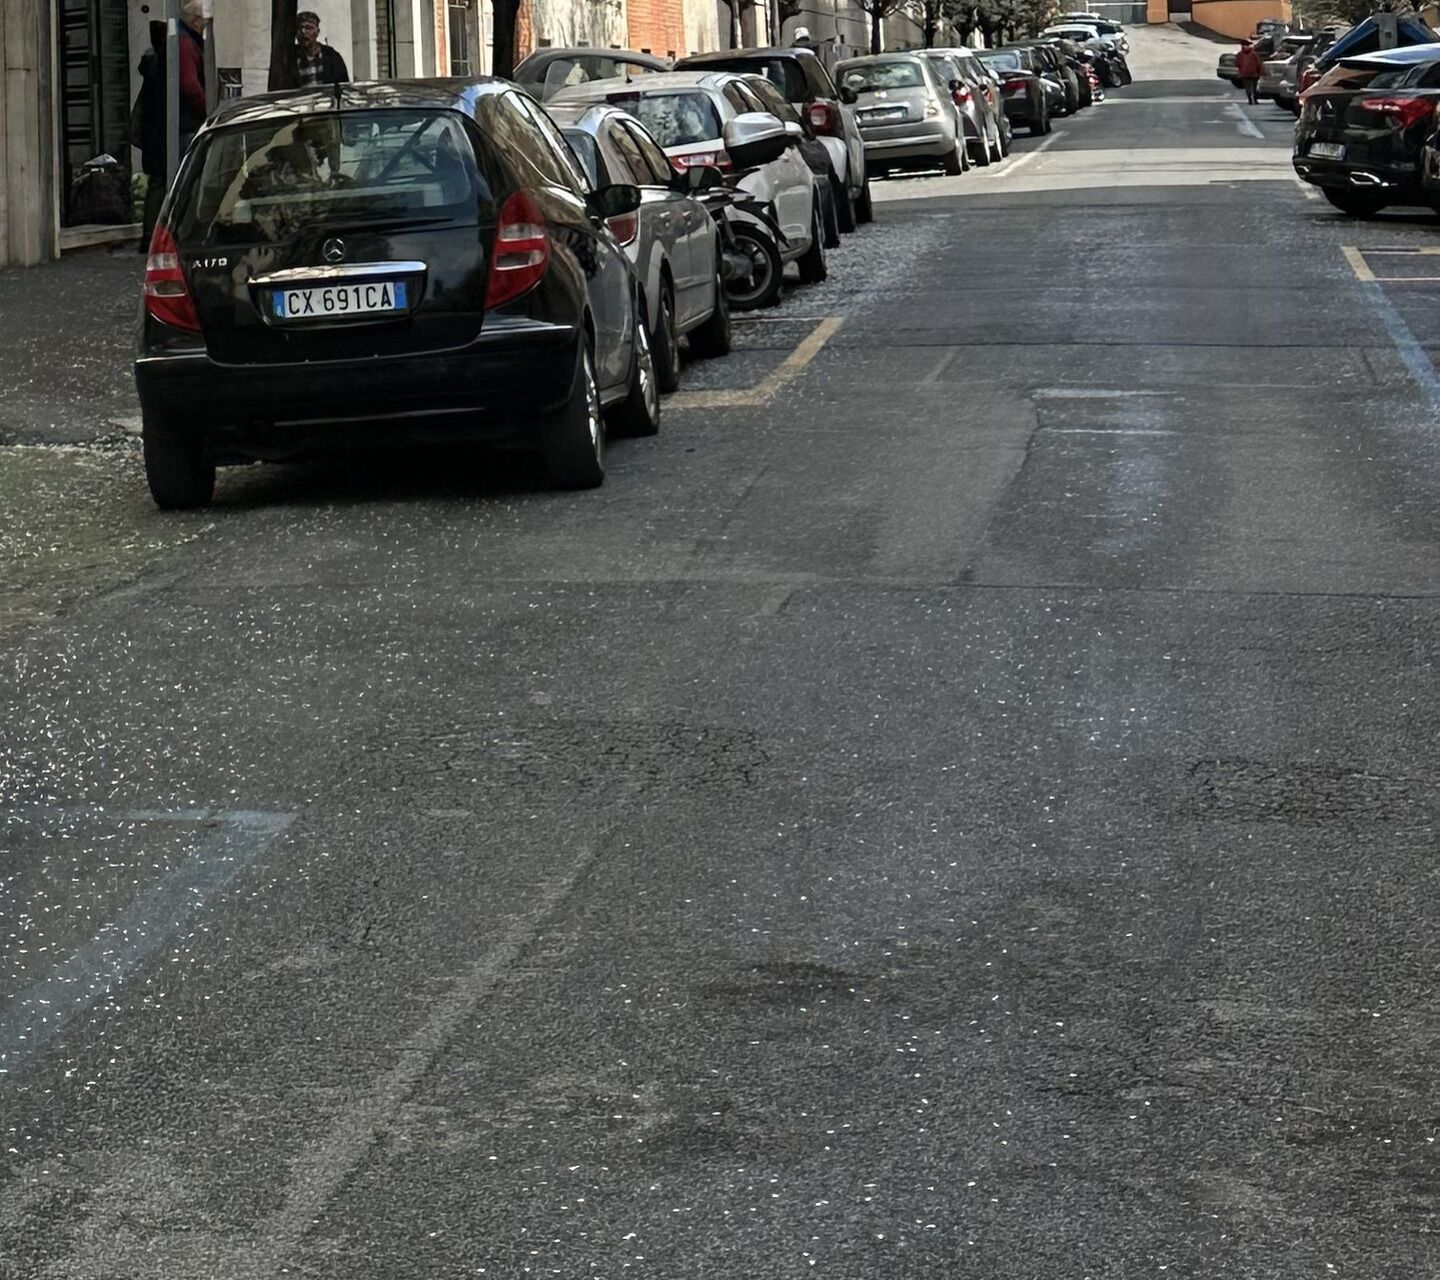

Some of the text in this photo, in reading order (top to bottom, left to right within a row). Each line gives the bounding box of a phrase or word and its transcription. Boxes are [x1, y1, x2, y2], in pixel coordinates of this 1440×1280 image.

[191, 257, 228, 269] A170
[287, 284, 393, 315] CX 691CA
